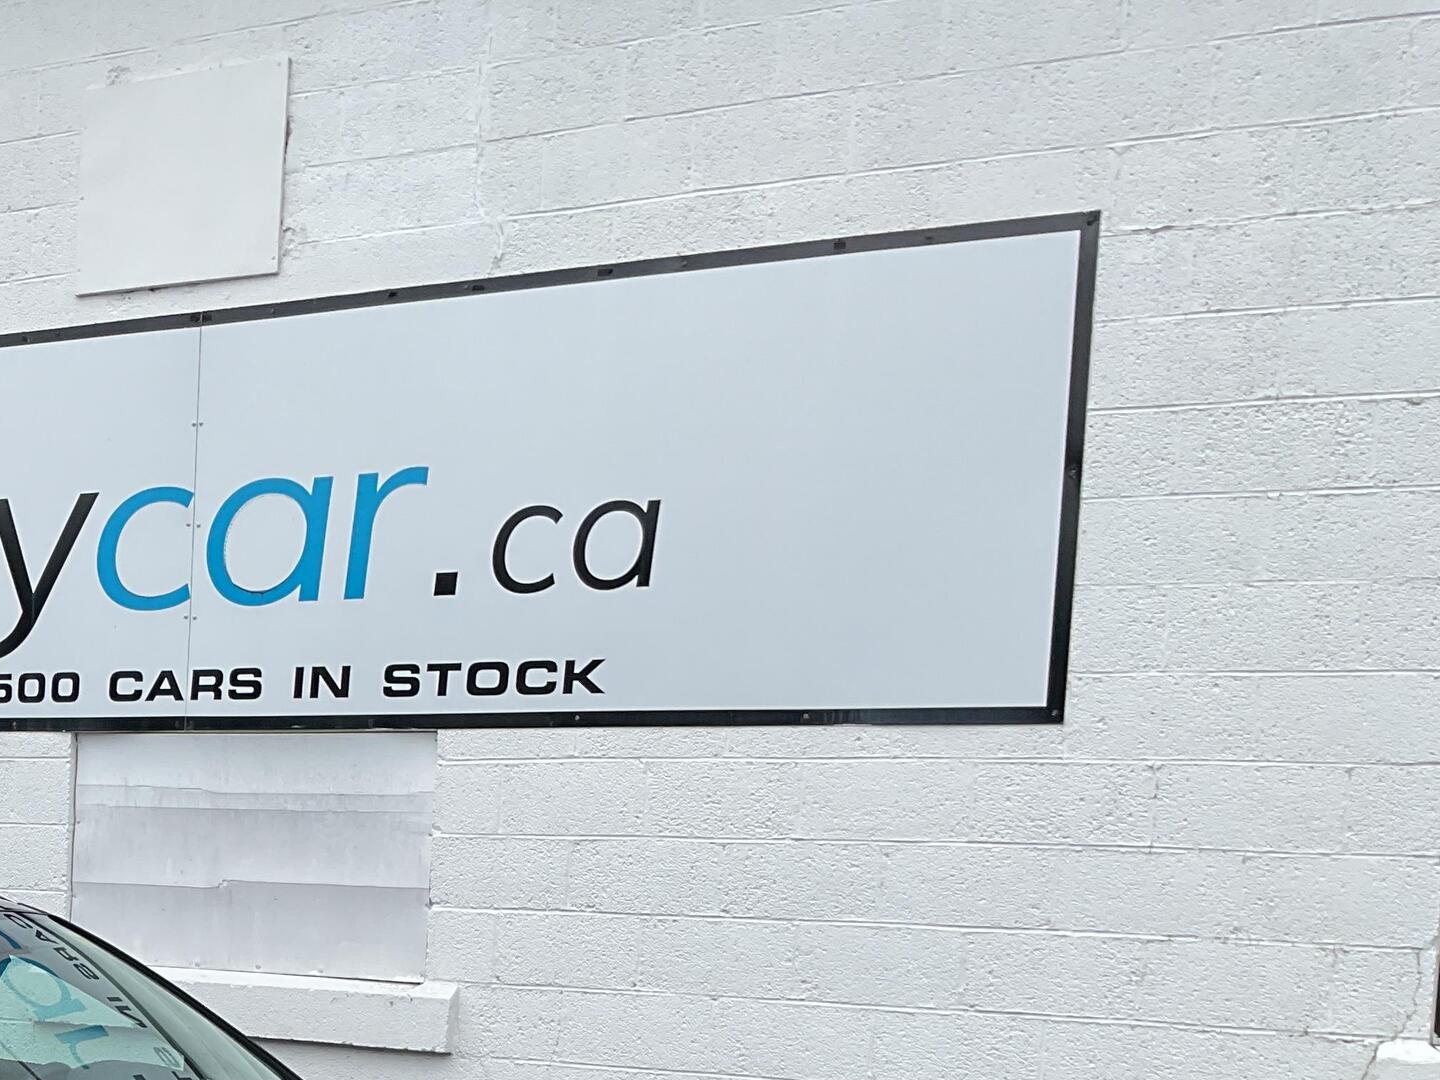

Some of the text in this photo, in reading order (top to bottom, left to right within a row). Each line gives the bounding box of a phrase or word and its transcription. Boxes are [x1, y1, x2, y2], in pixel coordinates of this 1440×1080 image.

[108, 667, 262, 702] CARS
[293, 665, 351, 699] IN
[382, 658, 606, 698] STOCK
